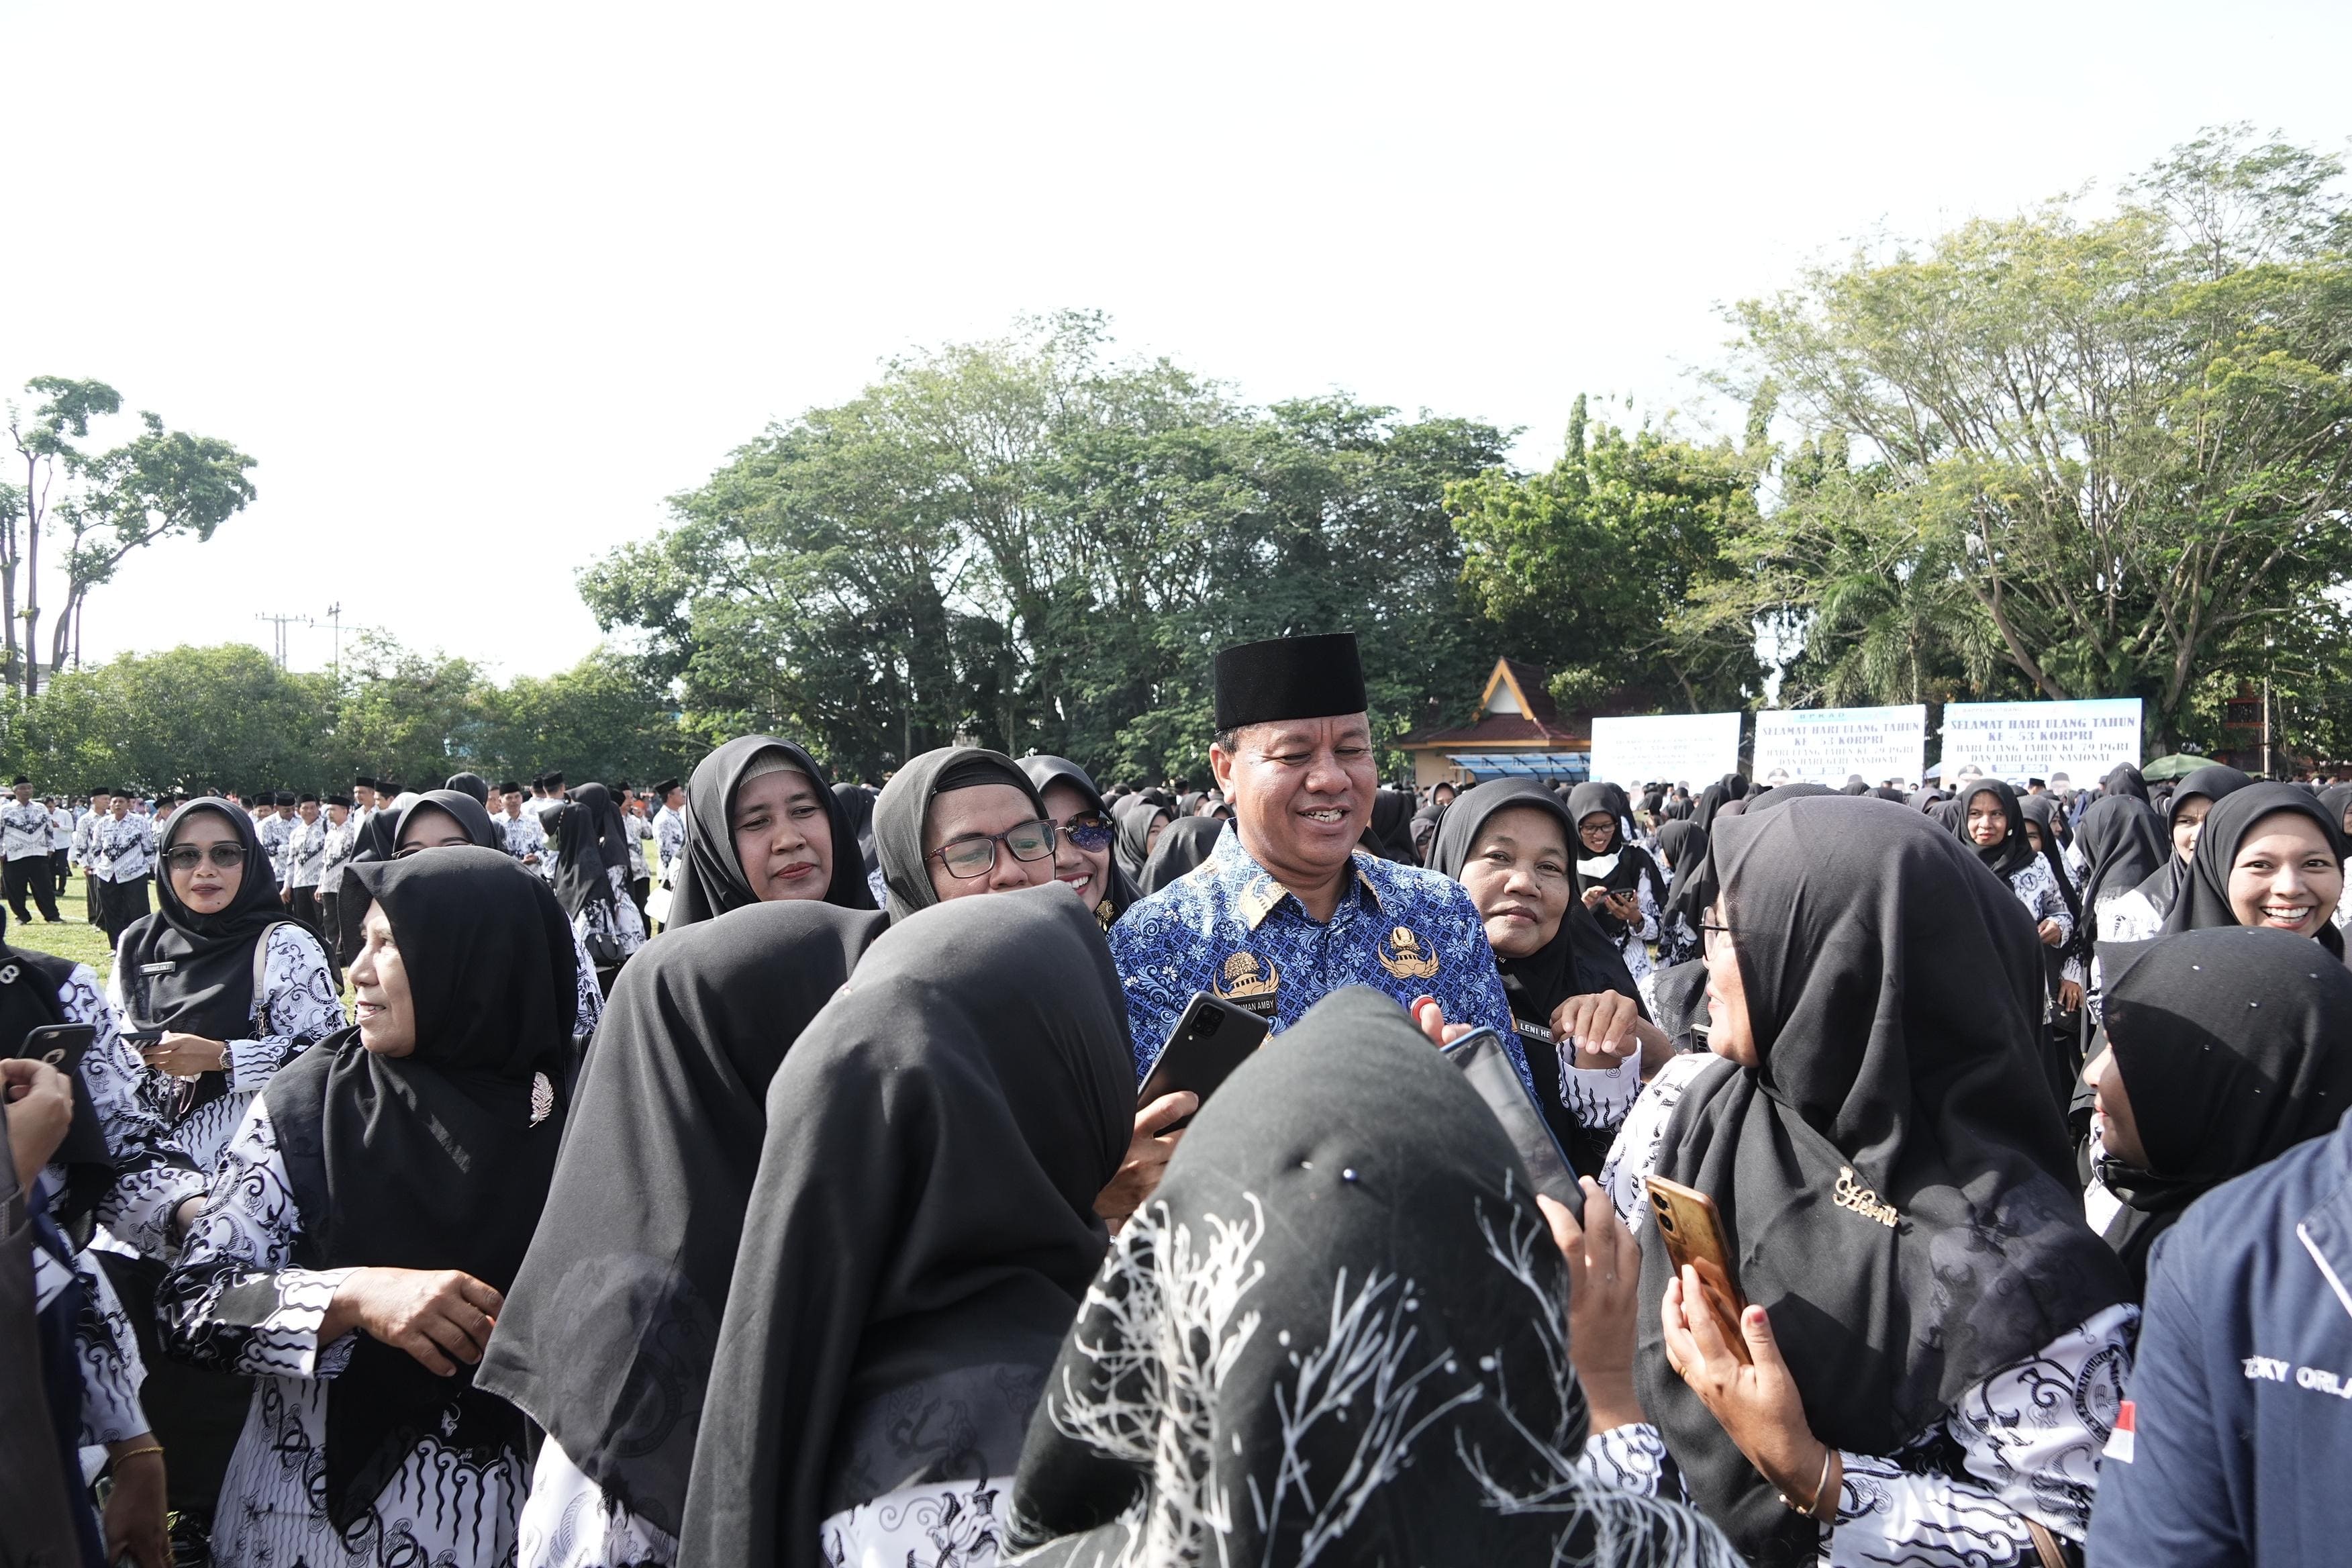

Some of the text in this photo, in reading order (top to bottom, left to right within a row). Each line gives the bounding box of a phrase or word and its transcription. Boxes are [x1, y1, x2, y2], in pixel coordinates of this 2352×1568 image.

[1763, 722, 1919, 736] SELAMAT HARI ULANG TAHUN
[1951, 717, 2135, 730] SELAMAT HARI ULANG TAHUN
[1795, 736, 1883, 746] KE 53 KORPRI
[1988, 732, 2004, 741] KE
[2018, 731, 2035, 741] 53
[2040, 730, 2093, 741] KORPRI
[1767, 748, 1788, 756] HARI
[1792, 748, 1820, 756] ULANG
[1825, 747, 1853, 756] TAHUN
[1890, 746, 1914, 754] PGRI
[1957, 744, 1981, 752] HARI
[1986, 744, 2018, 752] ULANG
[2024, 743, 2057, 752] TAHUN
[2100, 742, 2129, 751] PGRI
[1779, 757, 1796, 765] DAN
[1800, 757, 1822, 765] HARI
[1971, 752, 2110, 763] DAN HARI GURU NASIONAL
[1257, 999, 1274, 1010] AMBY
[1520, 1022, 1538, 1034] LENI
